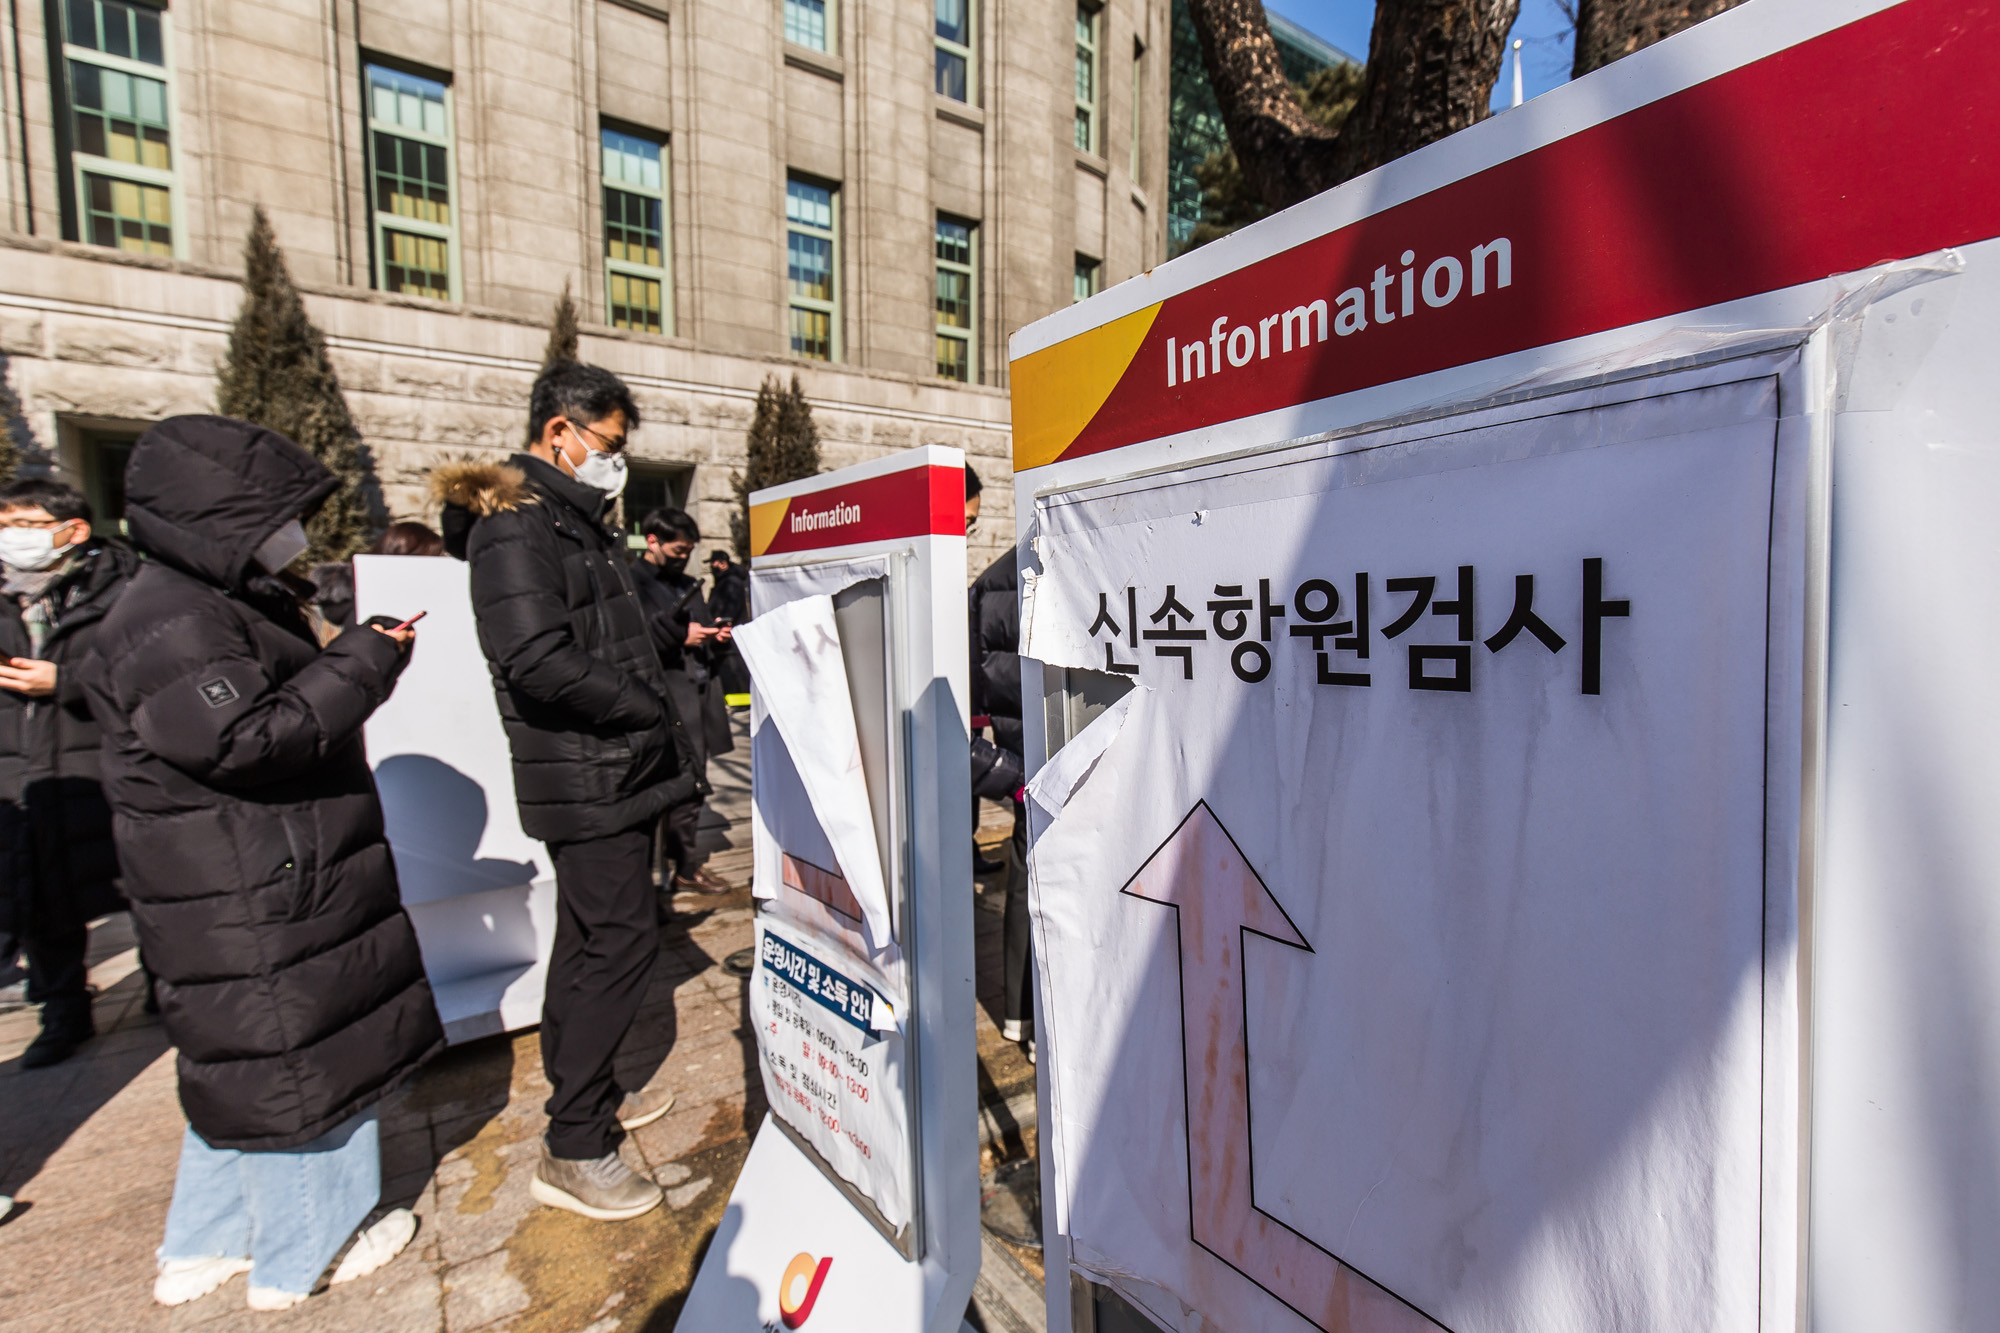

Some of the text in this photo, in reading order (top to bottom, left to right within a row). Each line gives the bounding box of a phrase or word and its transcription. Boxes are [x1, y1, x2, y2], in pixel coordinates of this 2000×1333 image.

[1166, 236, 1513, 388] Information
[791, 501, 861, 534] Information
[1088, 557, 1630, 696] 신속항원검사
[763, 936, 872, 1022] 운영시간 및 소독 안
[802, 1072, 837, 1110] 점심시간
